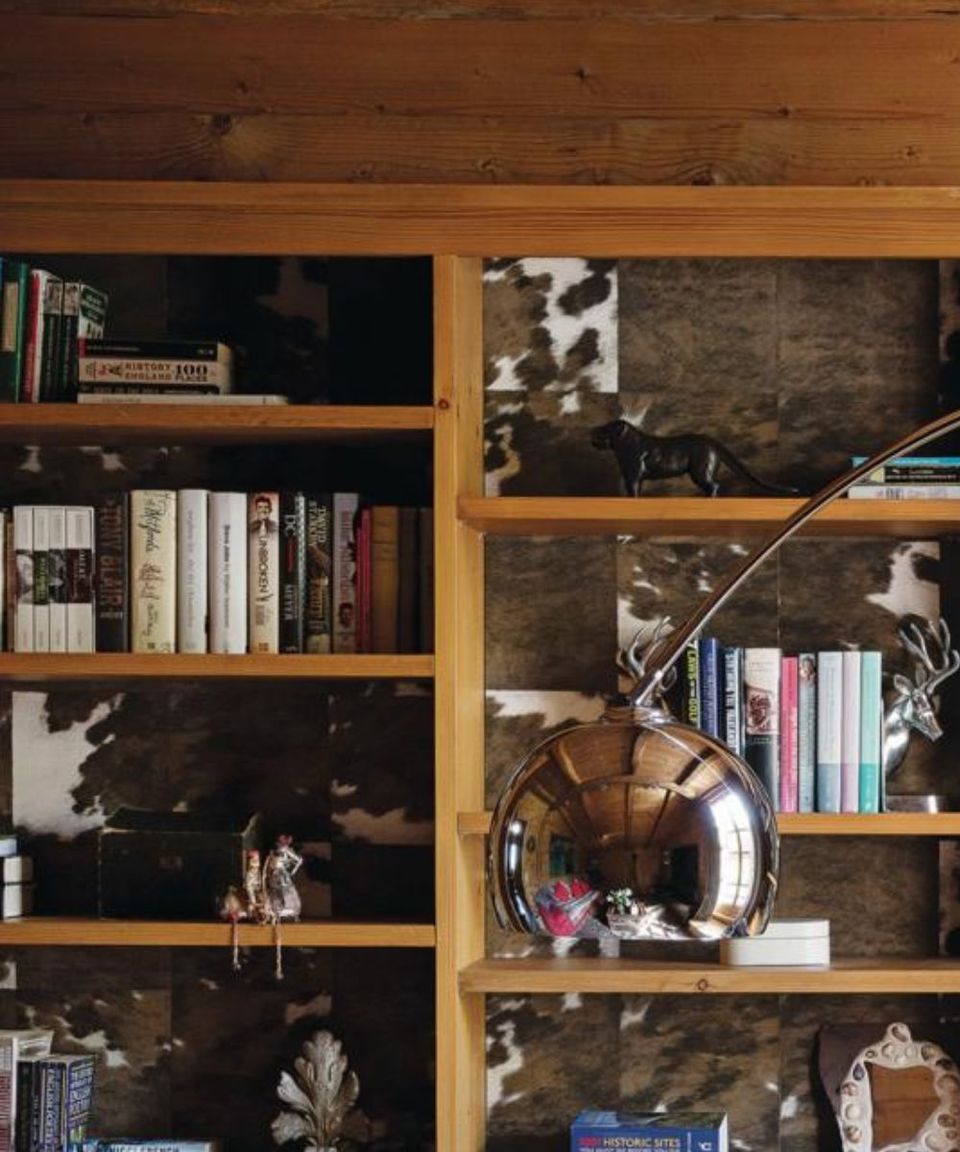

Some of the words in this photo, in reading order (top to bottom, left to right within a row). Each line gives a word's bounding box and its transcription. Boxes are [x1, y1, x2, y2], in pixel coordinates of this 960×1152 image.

[125, 363, 171, 371] HISTORY
[175, 363, 208, 375] 100
[125, 373, 172, 381] ENGLAND
[100, 505, 123, 550] TONY
[284, 513, 297, 537] DC
[258, 535, 269, 593] UNBROKEN
[603, 1138, 649, 1148] HISTORIC
[654, 1138, 681, 1148] SITES
